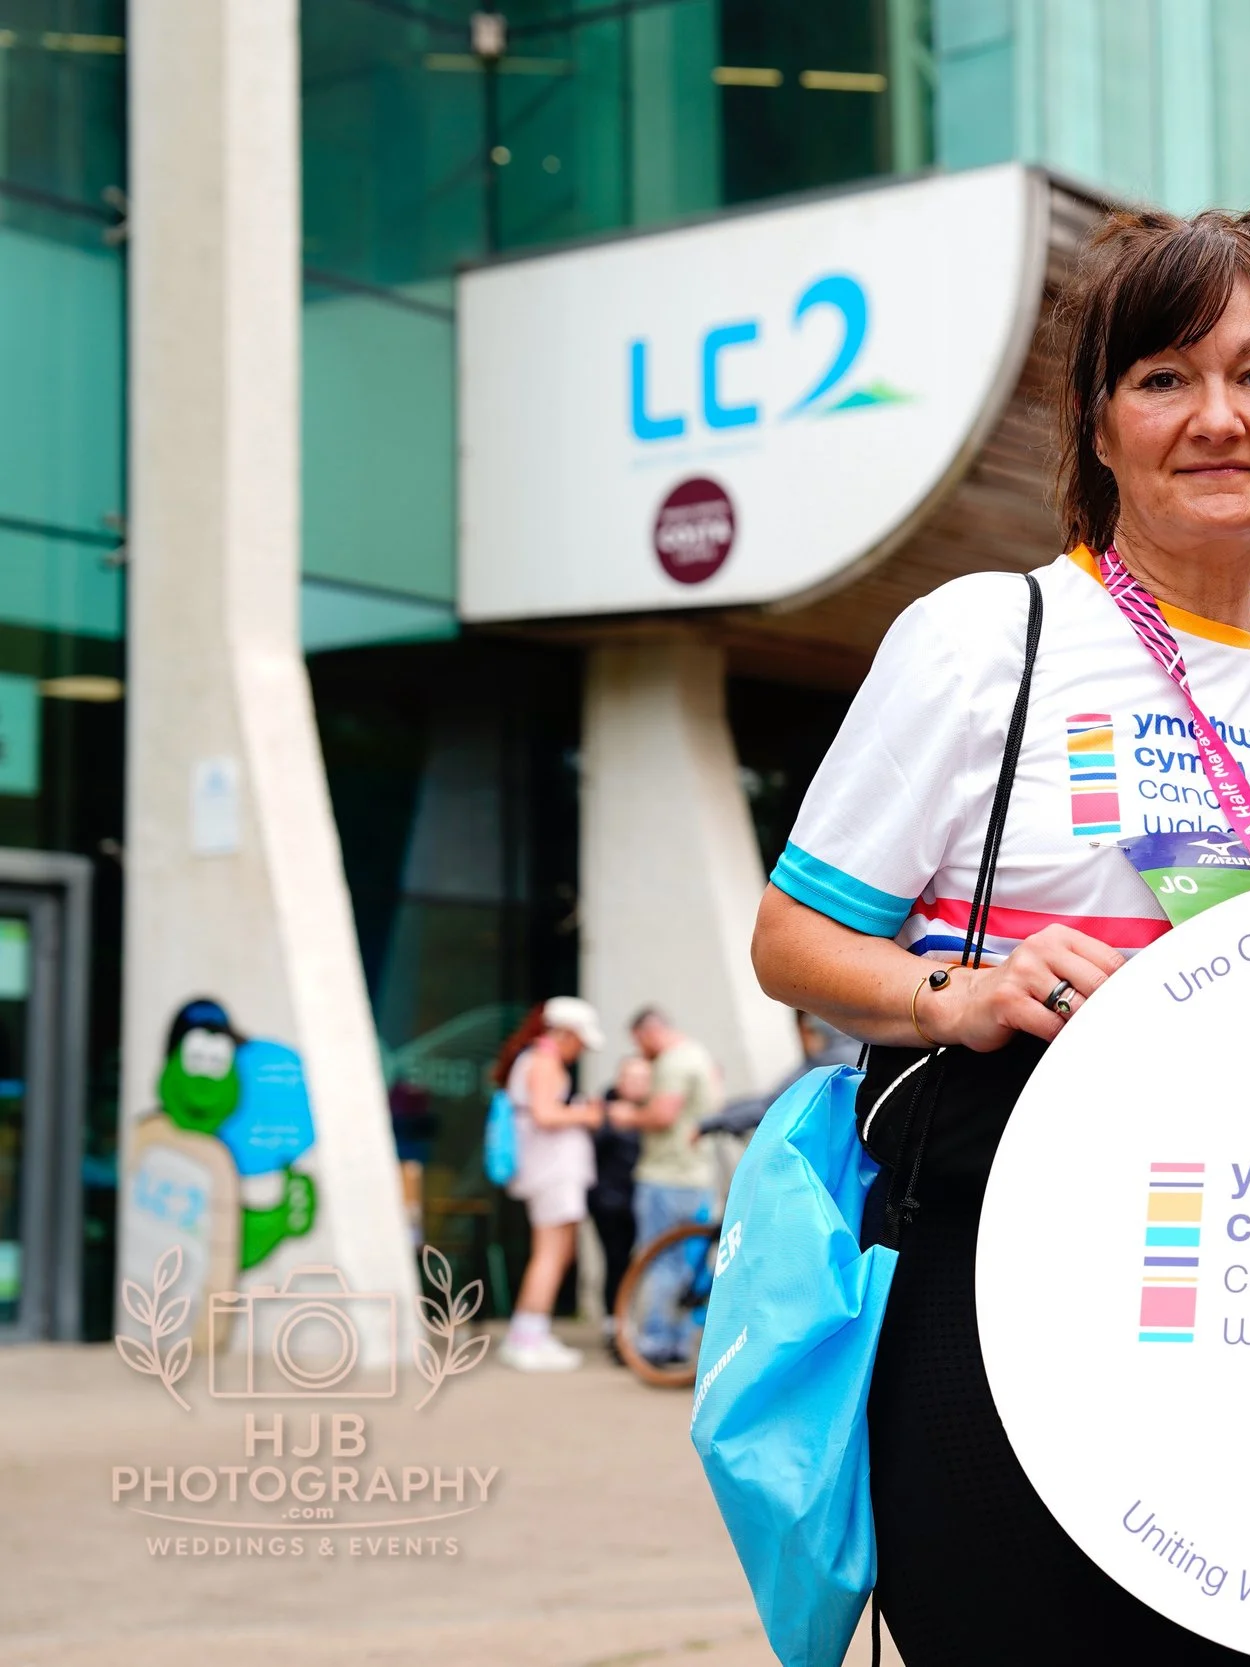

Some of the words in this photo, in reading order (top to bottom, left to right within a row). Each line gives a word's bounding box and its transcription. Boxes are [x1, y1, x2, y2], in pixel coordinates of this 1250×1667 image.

[630, 272, 869, 441] LC2
[1138, 779, 1221, 810] canc
[1160, 875, 1199, 894] JO
[1163, 956, 1231, 1002] Uno
[1123, 1500, 1228, 1596] Uniting
